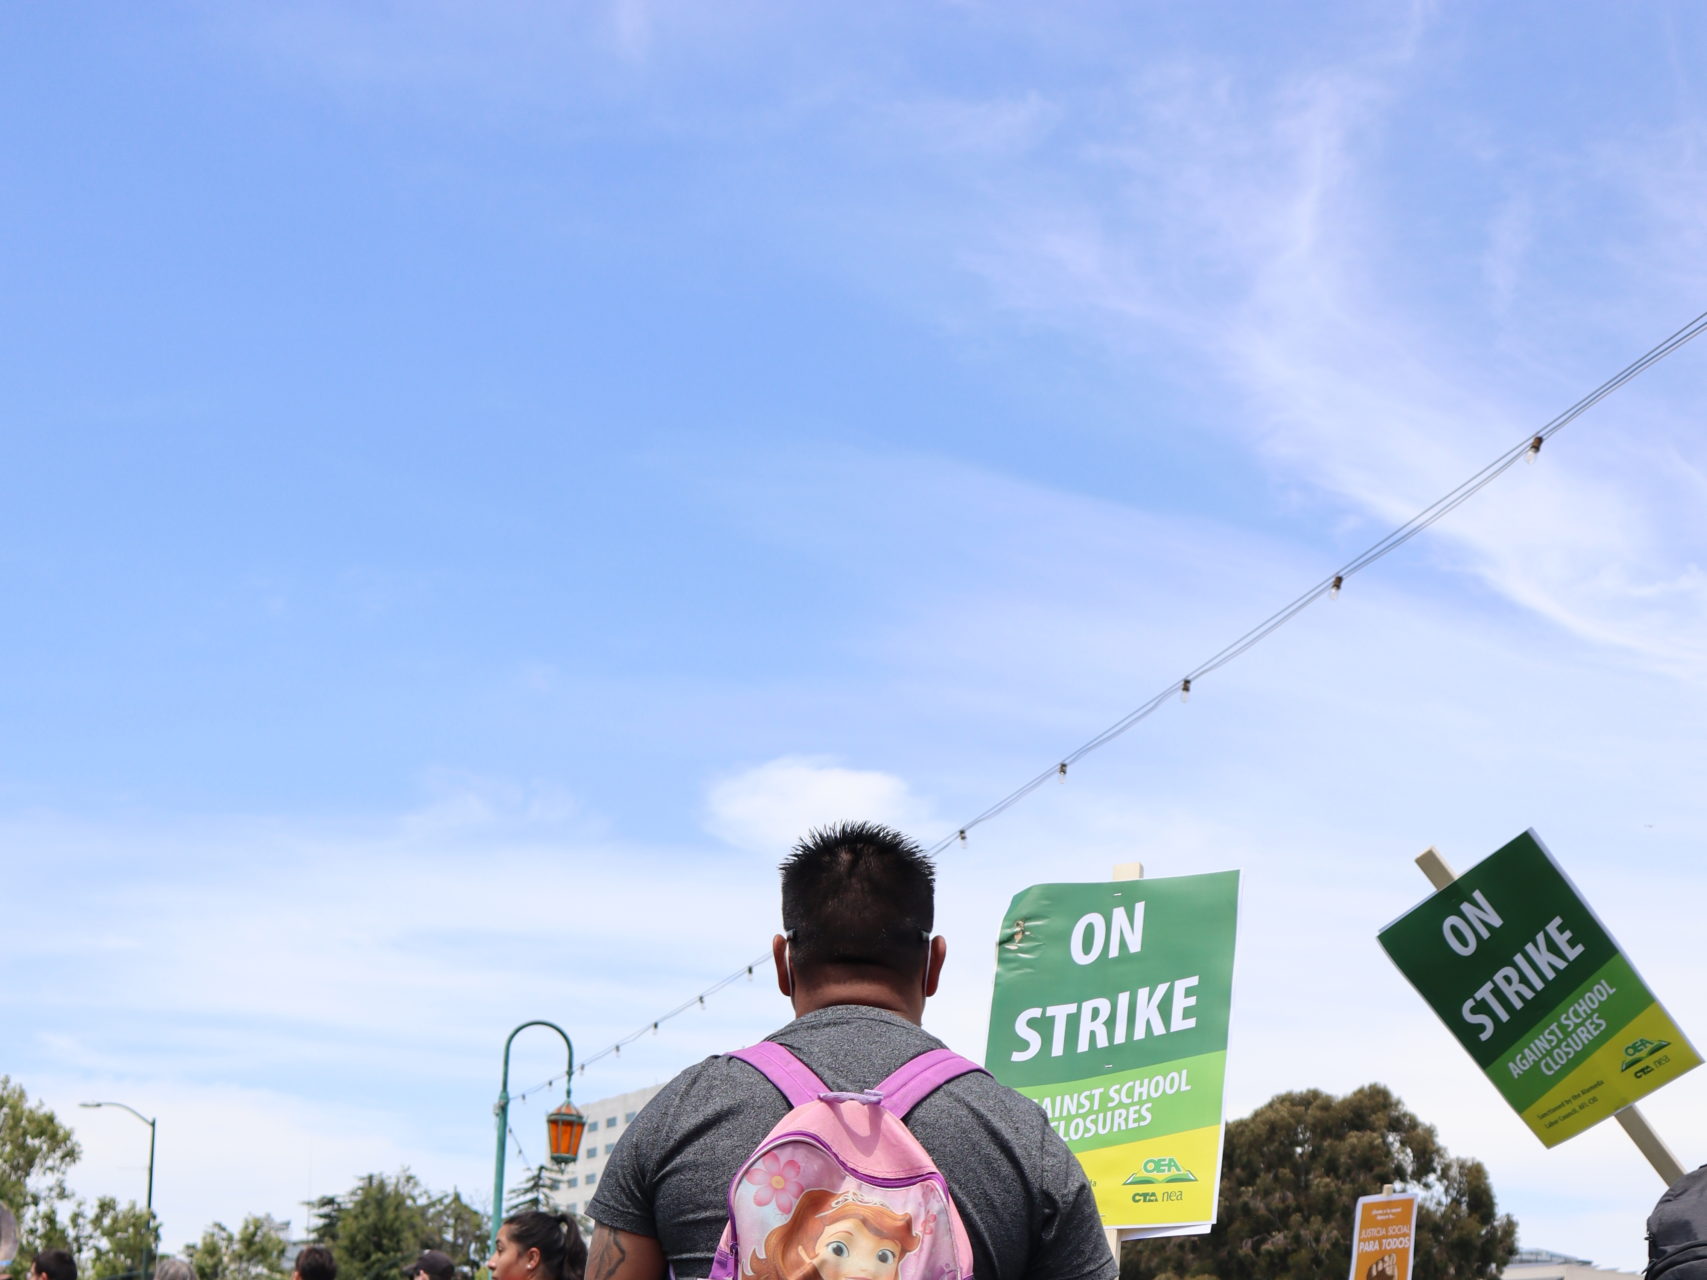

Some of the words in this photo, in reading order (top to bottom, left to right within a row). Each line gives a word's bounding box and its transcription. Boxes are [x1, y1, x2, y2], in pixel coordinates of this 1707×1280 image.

[1070, 901, 1146, 965] ON
[1442, 889, 1504, 957] ON
[1461, 915, 1586, 1041] STRIKE
[1010, 975, 1200, 1062] STRIKE
[1507, 1024, 1564, 1079] AGAINST
[1562, 979, 1616, 1032] SCHOOL
[1540, 1013, 1607, 1077] CLOSURES
[1624, 1039, 1652, 1057] OEA
[1032, 1088, 1104, 1118] AINST
[1109, 1069, 1191, 1107] SCHOOL
[1634, 1065, 1655, 1079] CTA
[1143, 1157, 1182, 1174] OEA
[1132, 1192, 1158, 1203] CTA
[1162, 1190, 1183, 1202] nea
[1359, 1241, 1379, 1253] PARA
[1381, 1237, 1410, 1250] TODOS
[1388, 1224, 1410, 1236] SOCIAL
